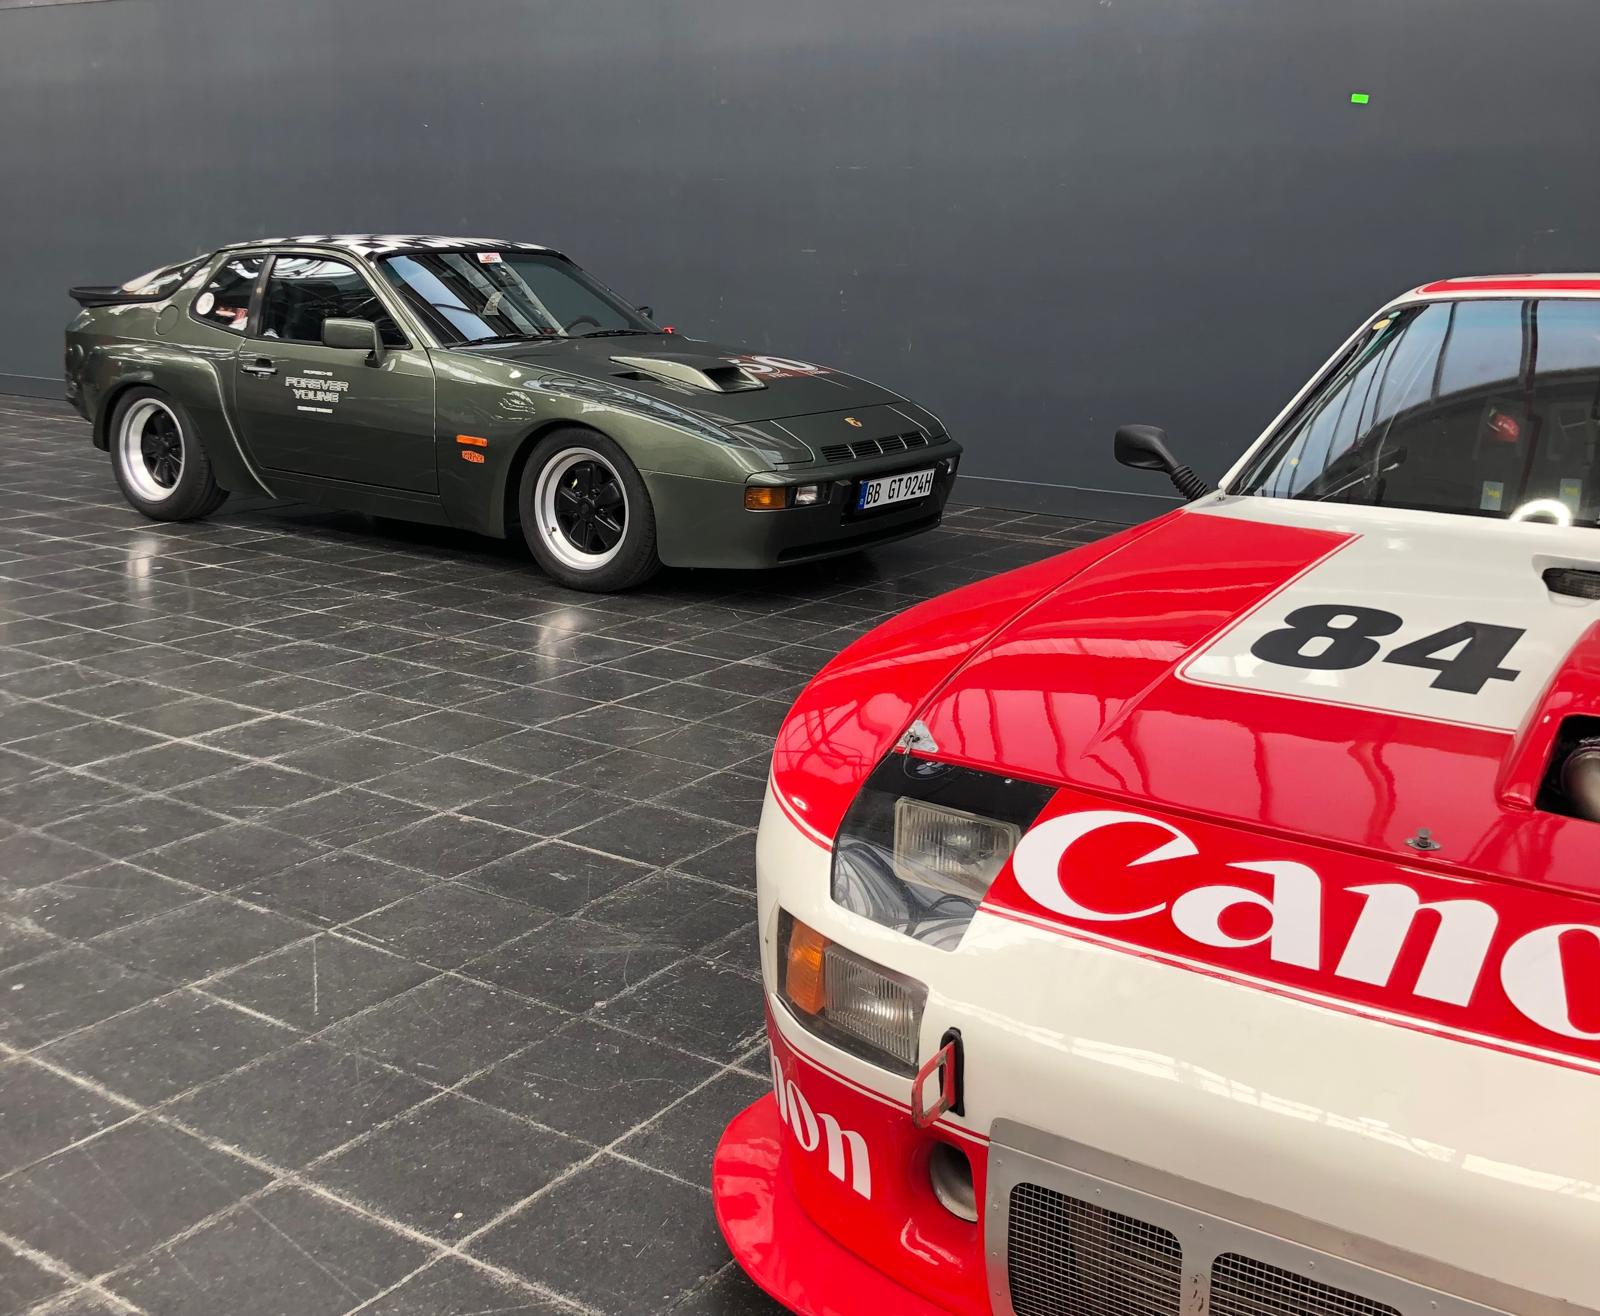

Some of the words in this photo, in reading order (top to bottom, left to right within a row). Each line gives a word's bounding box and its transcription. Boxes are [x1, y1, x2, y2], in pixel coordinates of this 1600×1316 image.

[285, 376, 349, 392] FOREVER
[865, 482, 882, 505] BB
[888, 477, 904, 500] GT
[904, 472, 933, 497] 924H
[1250, 604, 1527, 695] 84
